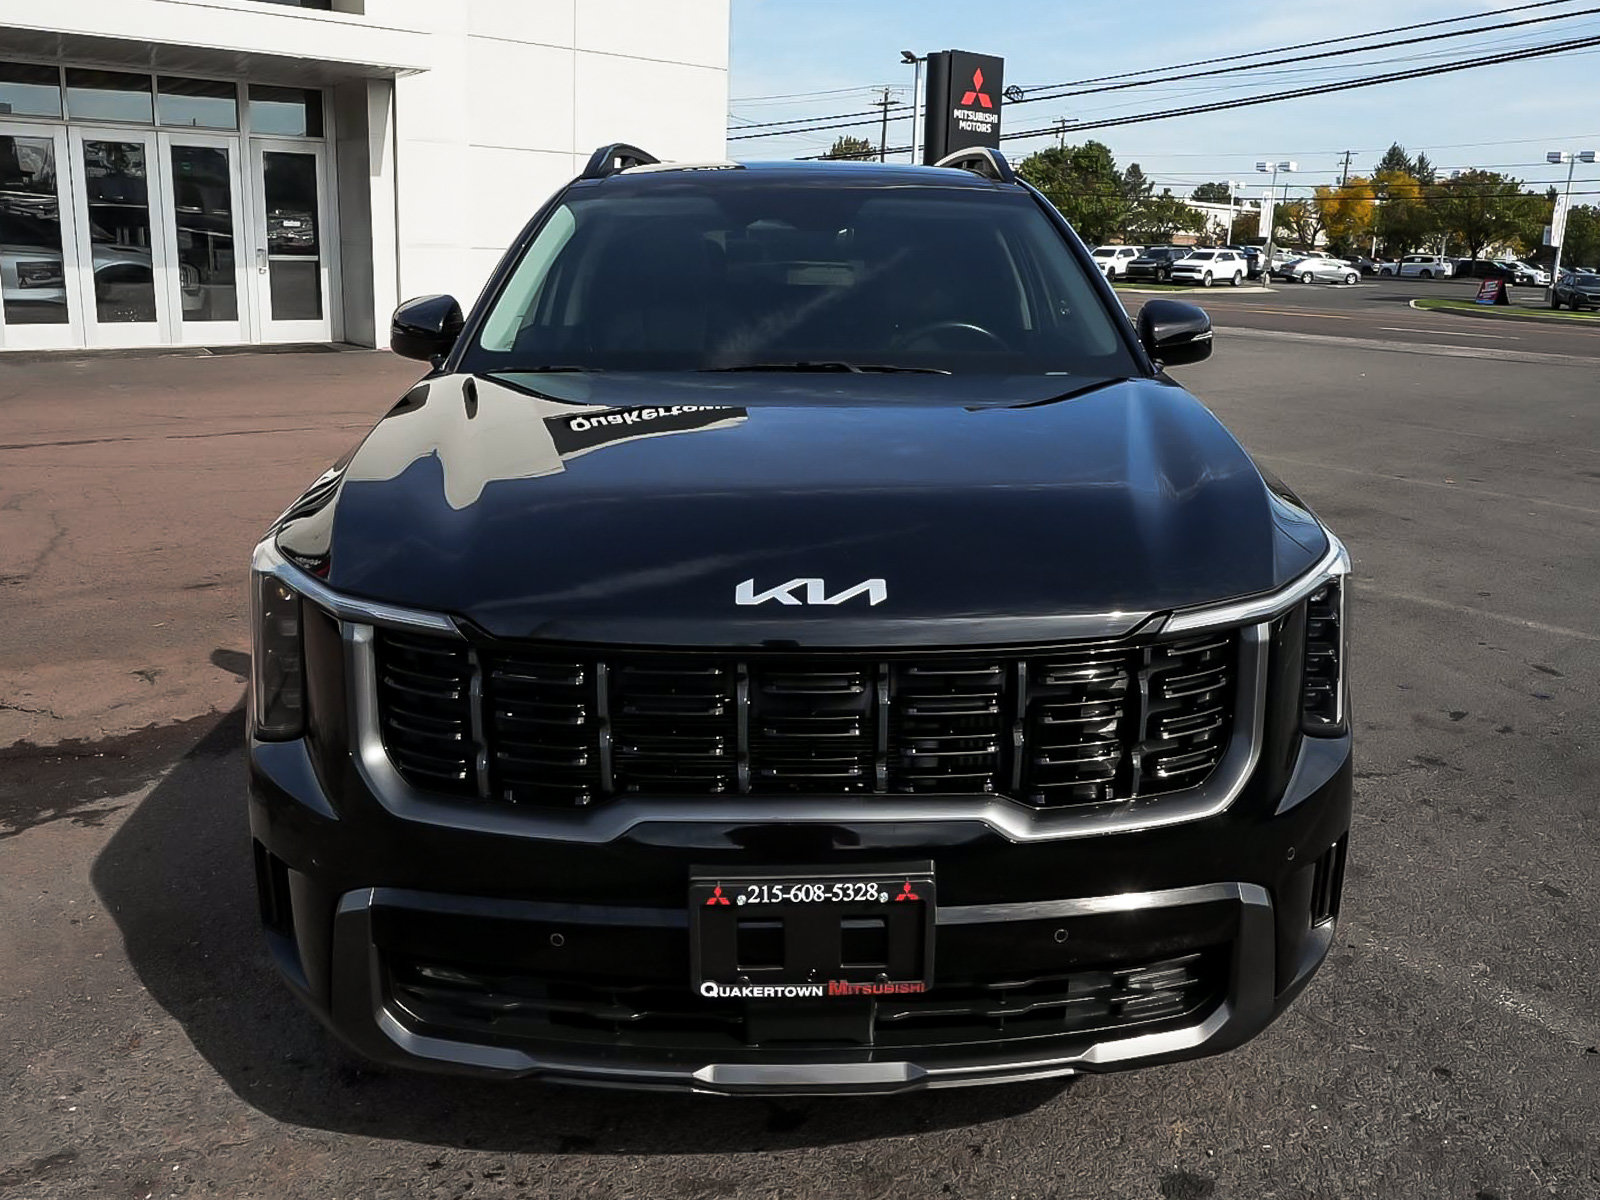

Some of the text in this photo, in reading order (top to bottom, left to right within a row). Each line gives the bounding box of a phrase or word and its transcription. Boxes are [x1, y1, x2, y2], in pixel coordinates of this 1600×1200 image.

[954, 109, 998, 123] MITSUBISHI
[959, 120, 992, 133] MOTORS
[735, 578, 887, 606] KIA
[747, 882, 878, 904] 215-608-5328
